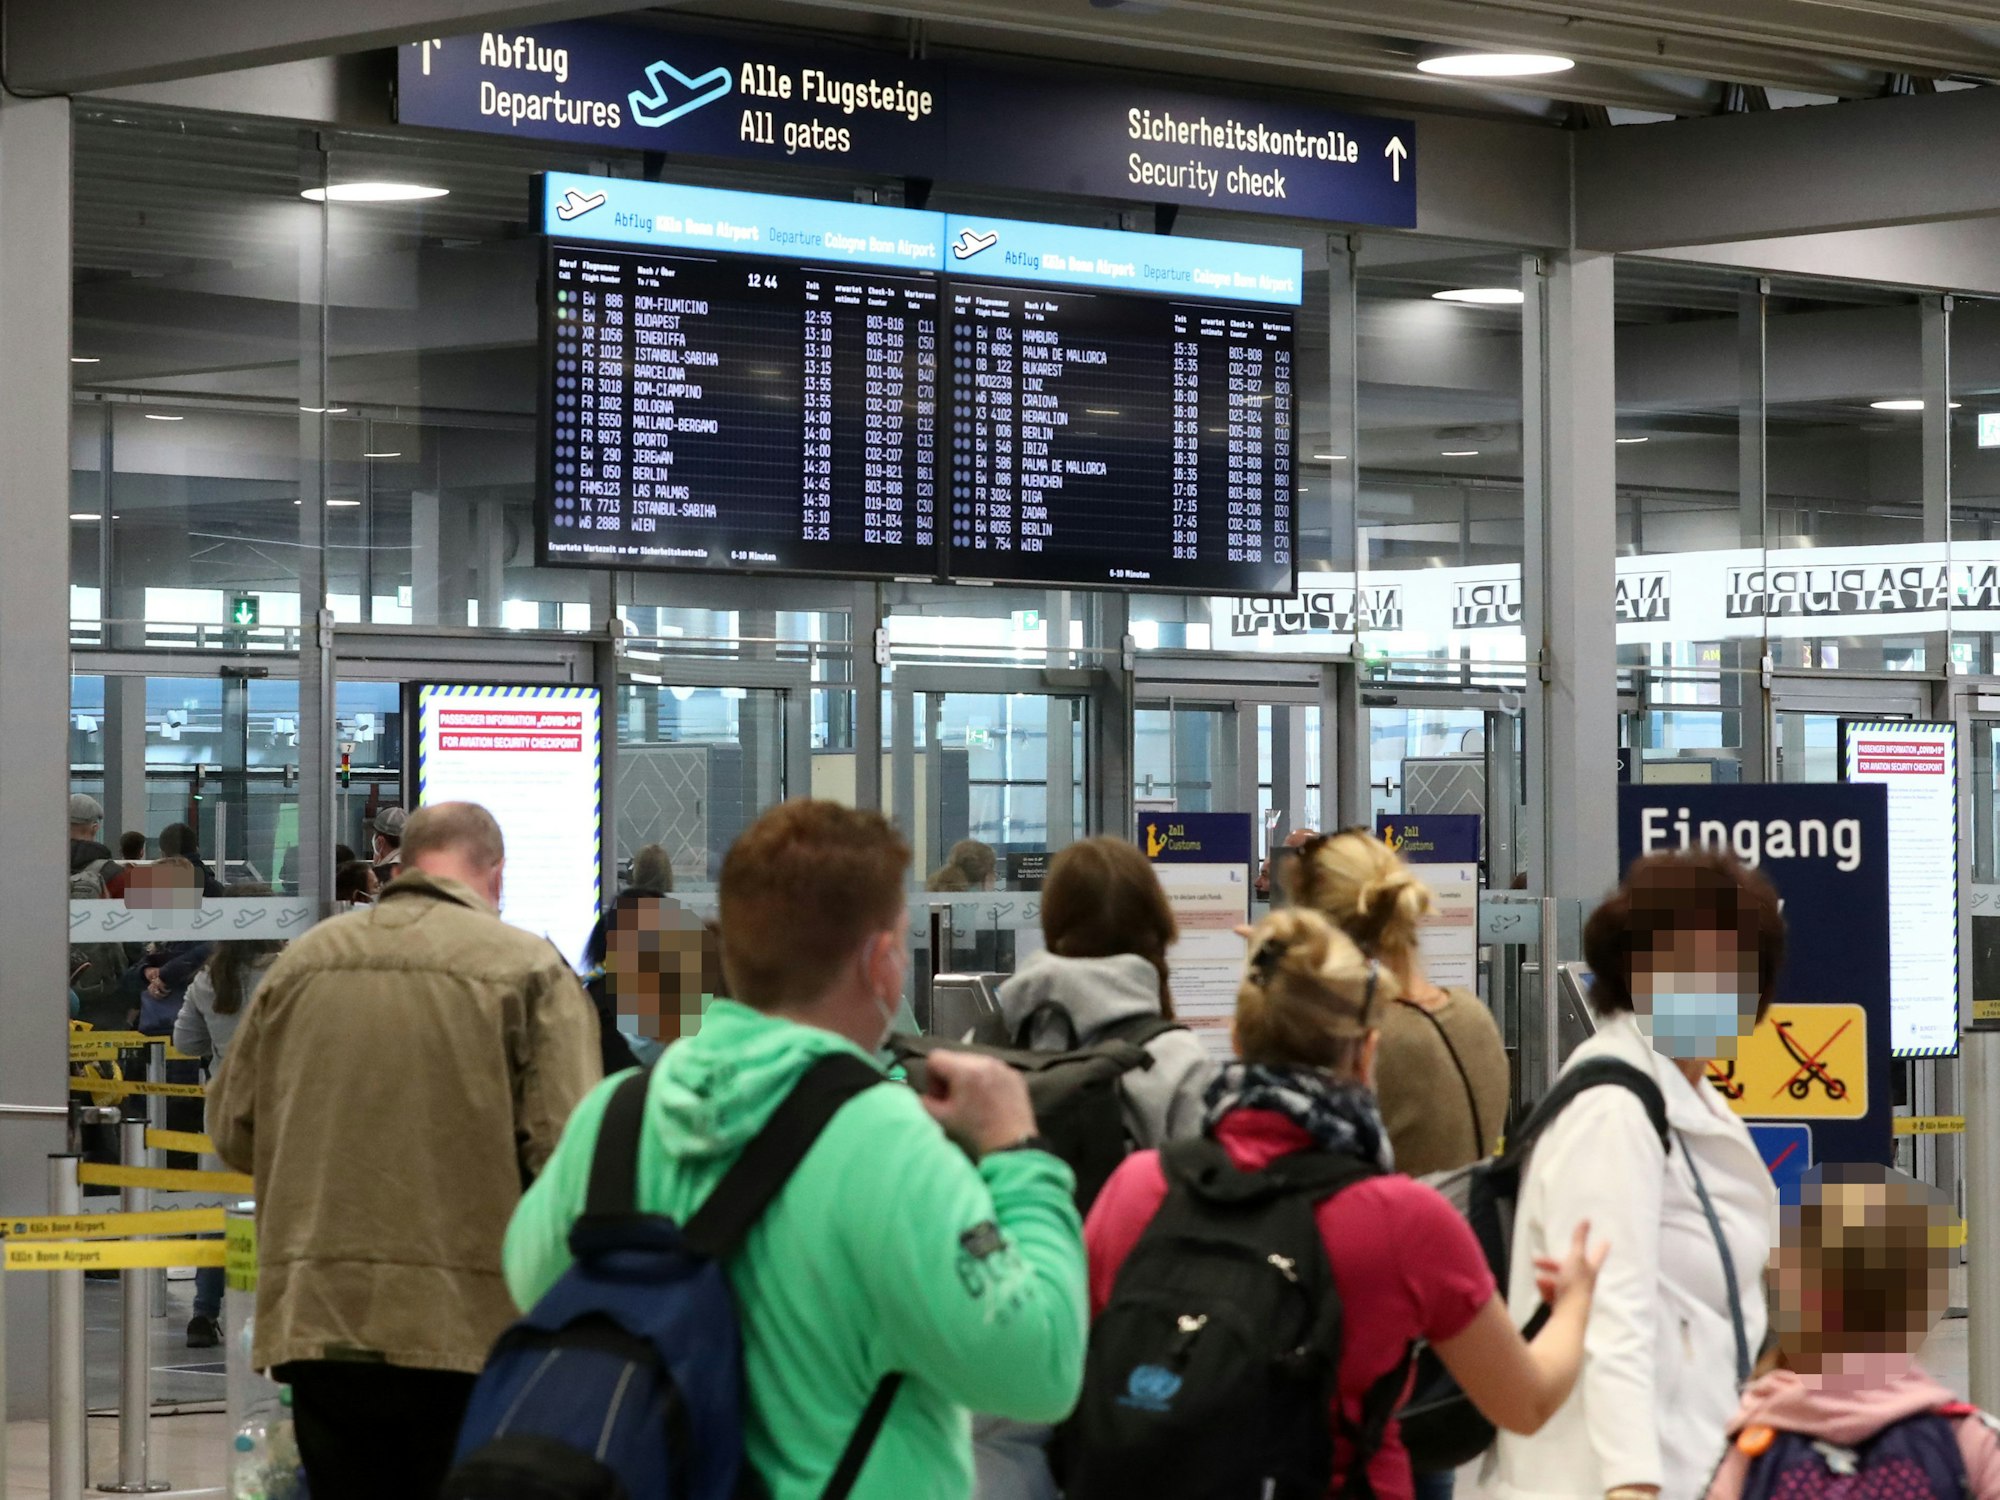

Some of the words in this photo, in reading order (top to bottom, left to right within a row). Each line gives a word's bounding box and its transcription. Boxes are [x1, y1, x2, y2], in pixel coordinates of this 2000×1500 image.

[480, 32, 568, 82] Abflug
[480, 81, 620, 129] Departures
[741, 63, 792, 100] Alle
[802, 69, 932, 122] Flugsteige
[741, 110, 773, 144] All
[784, 116, 850, 155] gates
[1128, 107, 1358, 164] Sicherheitskontrolle
[1128, 153, 1218, 197] Security
[1226, 164, 1287, 199] check
[614, 212, 652, 233] Abflug
[686, 217, 713, 237] Bonn
[716, 219, 759, 242] Airport
[769, 227, 821, 247] Departure
[824, 232, 866, 253] Cologne
[869, 236, 894, 254] Bonn
[897, 238, 936, 259] Airport
[747, 273, 761, 287] 12
[764, 274, 778, 289] 44
[1005, 250, 1039, 270] Abflug
[1069, 256, 1093, 273] Bonn
[1096, 257, 1135, 279] Airport
[1144, 264, 1191, 282] Departure
[1193, 269, 1231, 288] Cologne
[1233, 272, 1257, 289] Bonn
[1259, 274, 1294, 293] Airport
[583, 291, 595, 305] EW
[605, 293, 622, 307] 886
[635, 296, 707, 314] ROM-FIUMICINO
[805, 310, 831, 325] 12:55
[867, 316, 903, 331] B03-B16
[918, 320, 933, 333] C11
[583, 308, 595, 322] EW
[605, 310, 622, 324] 788
[635, 313, 679, 329] BUDAPEST
[805, 327, 831, 341] 13:10
[867, 332, 903, 347] B03-B16
[918, 336, 933, 350] C50
[582, 325, 594, 339] XR
[600, 327, 622, 341] 1056
[634, 330, 685, 346] TENERIFFA
[805, 343, 831, 358] 13:10
[866, 348, 903, 363] D16-D17
[918, 352, 934, 366] C40
[582, 343, 594, 356] PC
[599, 344, 622, 359] 1012
[635, 347, 718, 366] ISTANBUL-SABIHA
[805, 360, 831, 374] 13:15
[866, 365, 903, 380] D01-D04
[918, 369, 933, 382] B40
[976, 325, 987, 338] EW
[996, 327, 1012, 340] 034
[1022, 329, 1057, 344] HAMBURG
[1174, 343, 1197, 356] 15:35
[1229, 347, 1261, 362] B03-B08
[1275, 351, 1289, 364] C40
[976, 342, 986, 354] FR
[991, 343, 1011, 356] 8662
[1023, 345, 1048, 359] PALMA
[1052, 348, 1062, 361] DE
[1066, 349, 1106, 364] MALLORCA
[1174, 358, 1197, 372] 15:35
[1229, 363, 1261, 377] C02-C07
[1275, 367, 1288, 379] C12
[582, 360, 593, 374] FR
[598, 361, 622, 376] 2508
[634, 364, 685, 380] BARCELONA
[804, 377, 831, 391] 13:55
[866, 381, 902, 396] C02-C07
[918, 385, 933, 398] C70
[582, 377, 593, 391] FR
[598, 378, 622, 393] 3018
[634, 381, 701, 398] ROM-CIAMPINO
[804, 393, 831, 407] 13:55
[866, 398, 903, 412] C02-C07
[917, 401, 933, 415] B80
[582, 394, 593, 408] FR
[599, 396, 621, 410] 1602
[634, 398, 673, 413] BOLOGNA
[804, 410, 830, 424] 14:00
[866, 414, 902, 429] C02-C07
[918, 418, 932, 431] C12
[975, 390, 986, 403] W6
[991, 391, 1011, 405] 3988
[1022, 394, 1057, 408] CRAIOVA
[1173, 405, 1197, 418] 16:00
[1229, 409, 1261, 423] D23-D24
[1275, 413, 1289, 425] B31
[976, 406, 986, 419] X3
[991, 407, 1011, 421] 4102
[1022, 410, 1067, 425] HERAKLION
[1174, 420, 1197, 434] 16:05
[1228, 424, 1261, 438] D05-D06
[1275, 428, 1289, 440] D10
[976, 423, 986, 435] EW
[996, 424, 1011, 437] 006
[1022, 426, 1052, 440] BERLIN
[1174, 436, 1197, 449] 16:10
[1229, 440, 1261, 454] B03-B08
[1275, 443, 1288, 455] C50
[640, 545, 708, 558] Sicherheitskontrolle
[731, 550, 747, 560] 6-10
[748, 551, 777, 561] Minuten
[1109, 568, 1124, 578] 6-10
[1125, 569, 1151, 579] Minuten
[440, 713, 485, 725] PASSENGER
[486, 714, 537, 726] INFORMATION
[442, 736, 459, 748] FOR
[459, 736, 493, 748] AVIATION
[494, 737, 530, 748] SECURITY
[531, 737, 579, 749] CHECKPOINT
[1858, 744, 1886, 753] PASSENGER
[1886, 745, 1917, 754] INFORMATION
[1860, 762, 1869, 770] FOR
[1870, 762, 1891, 771] AVIATION
[1891, 763, 1913, 771] SECURITY
[1913, 763, 1943, 772] CHECKPOINT
[1168, 824, 1184, 836] Zoll
[1168, 840, 1201, 851] Customs
[1404, 825, 1419, 837] Zoll
[1404, 840, 1434, 851] Customs
[1641, 807, 1861, 872] Eingang
[51, 1222, 71, 1232] Bonn
[74, 1221, 105, 1232] Airport
[64, 1250, 100, 1262] Airport
